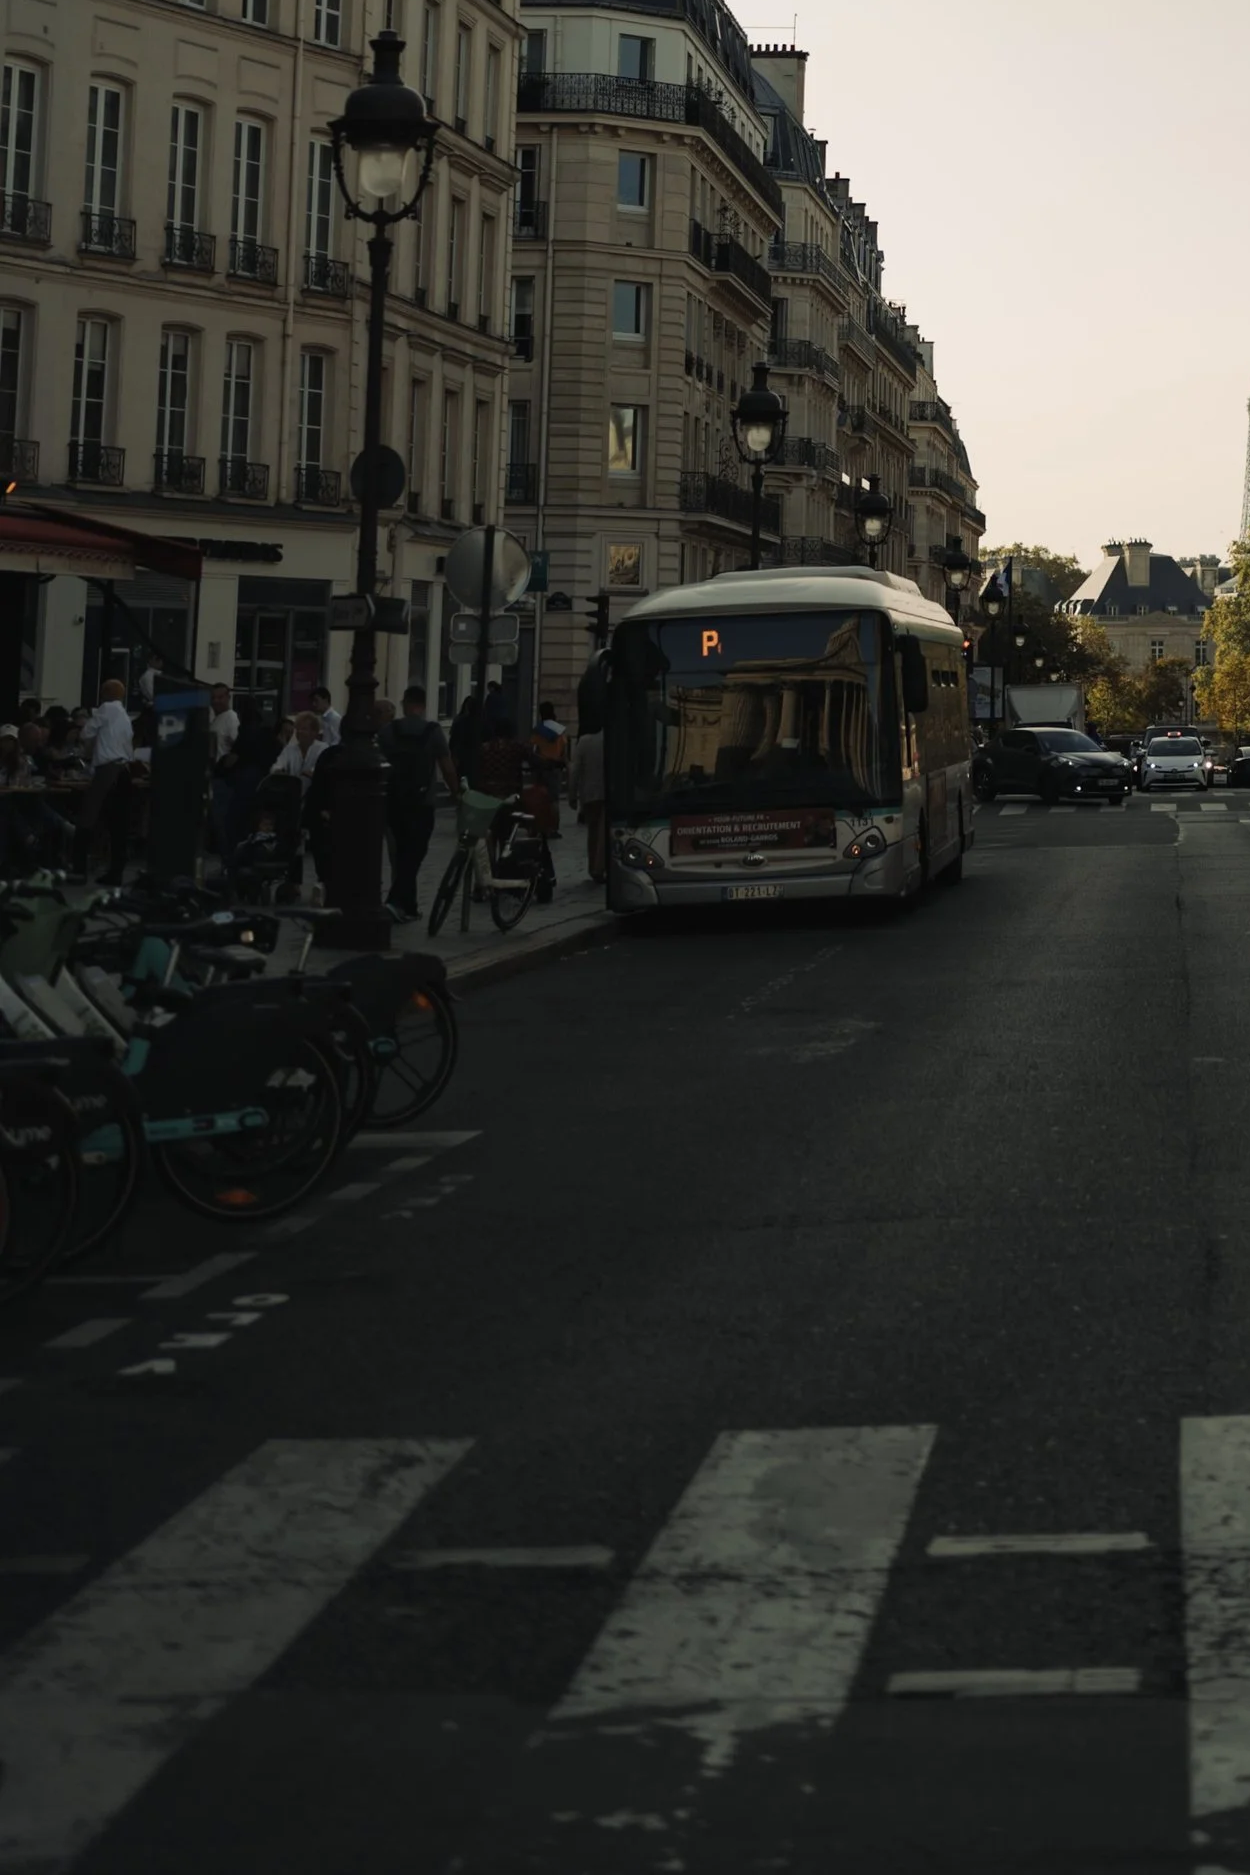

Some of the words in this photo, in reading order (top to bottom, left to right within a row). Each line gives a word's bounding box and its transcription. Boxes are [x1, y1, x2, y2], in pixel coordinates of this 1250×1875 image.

[702, 630, 722, 657] P
[676, 824, 732, 836] ORIENTATION
[733, 825, 740, 833] &
[742, 821, 801, 832] RECRUTEMENT
